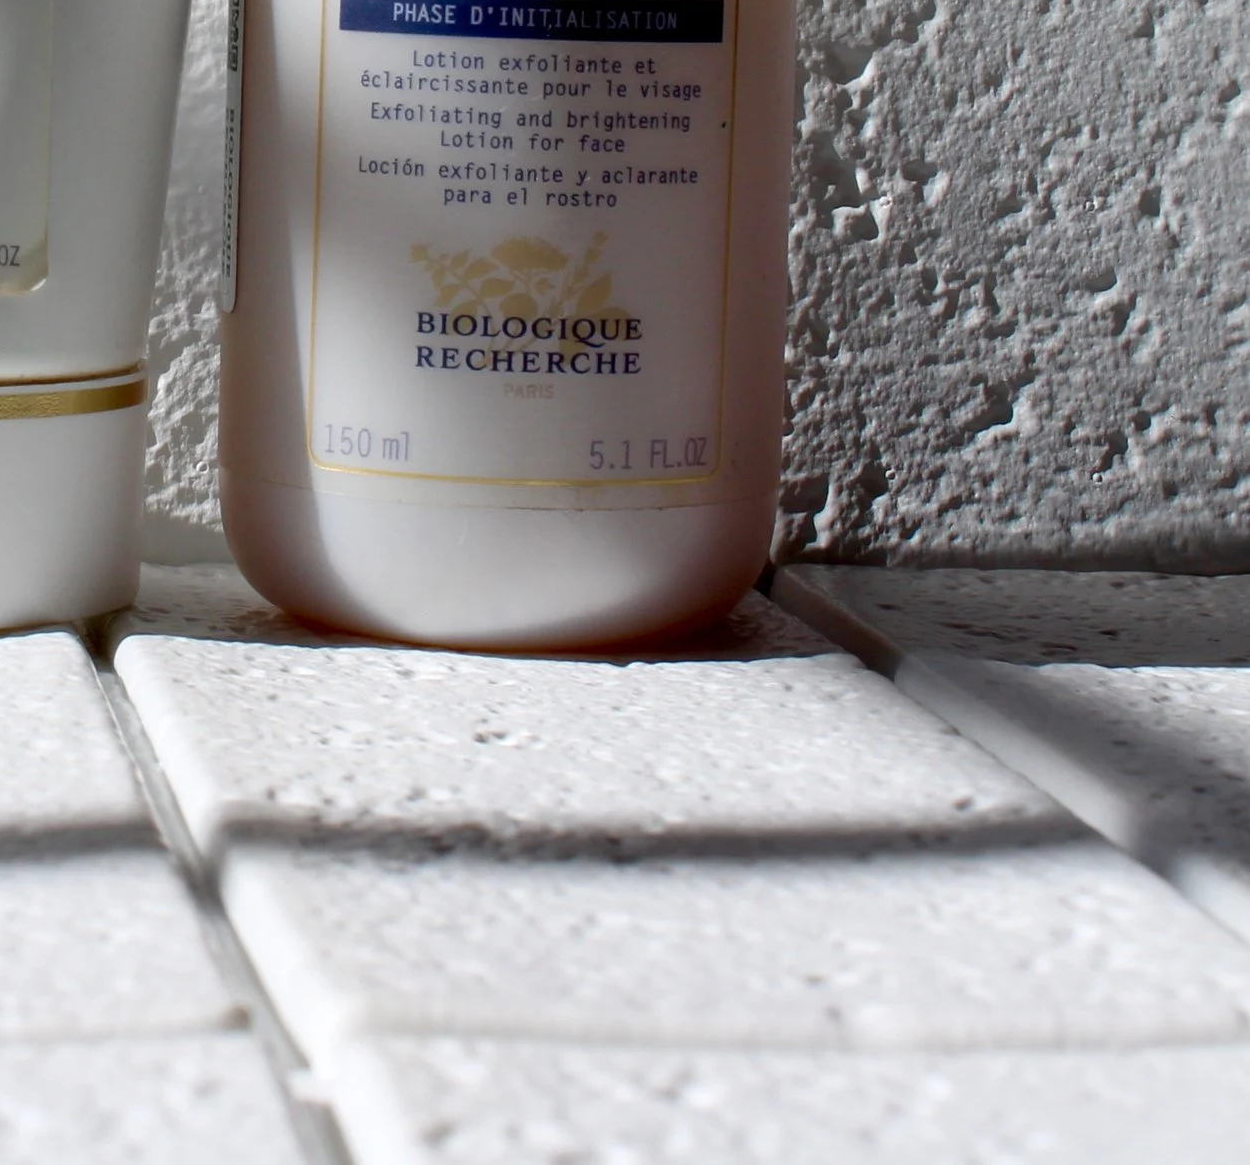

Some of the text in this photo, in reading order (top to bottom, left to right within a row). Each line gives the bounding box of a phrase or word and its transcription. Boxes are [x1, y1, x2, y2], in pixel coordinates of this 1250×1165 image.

[394, 3, 678, 31] PHASE D'INITIALISATION
[414, 50, 656, 74] Lotion exfoliante et
[361, 70, 701, 101] éclaircissante pour le visage
[371, 102, 690, 132] Exfoliating and brightening
[441, 130, 625, 152] Lotion for face
[359, 156, 698, 186] Loción exfoliante y aclarante
[444, 187, 616, 207] para el rostro
[416, 311, 642, 346] BIOLOGIQUE
[416, 346, 641, 375] RECHERCHE
[504, 383, 555, 400] PARIS
[324, 424, 409, 462] 150 ml
[590, 436, 708, 472] 5.1 FL.OZ
